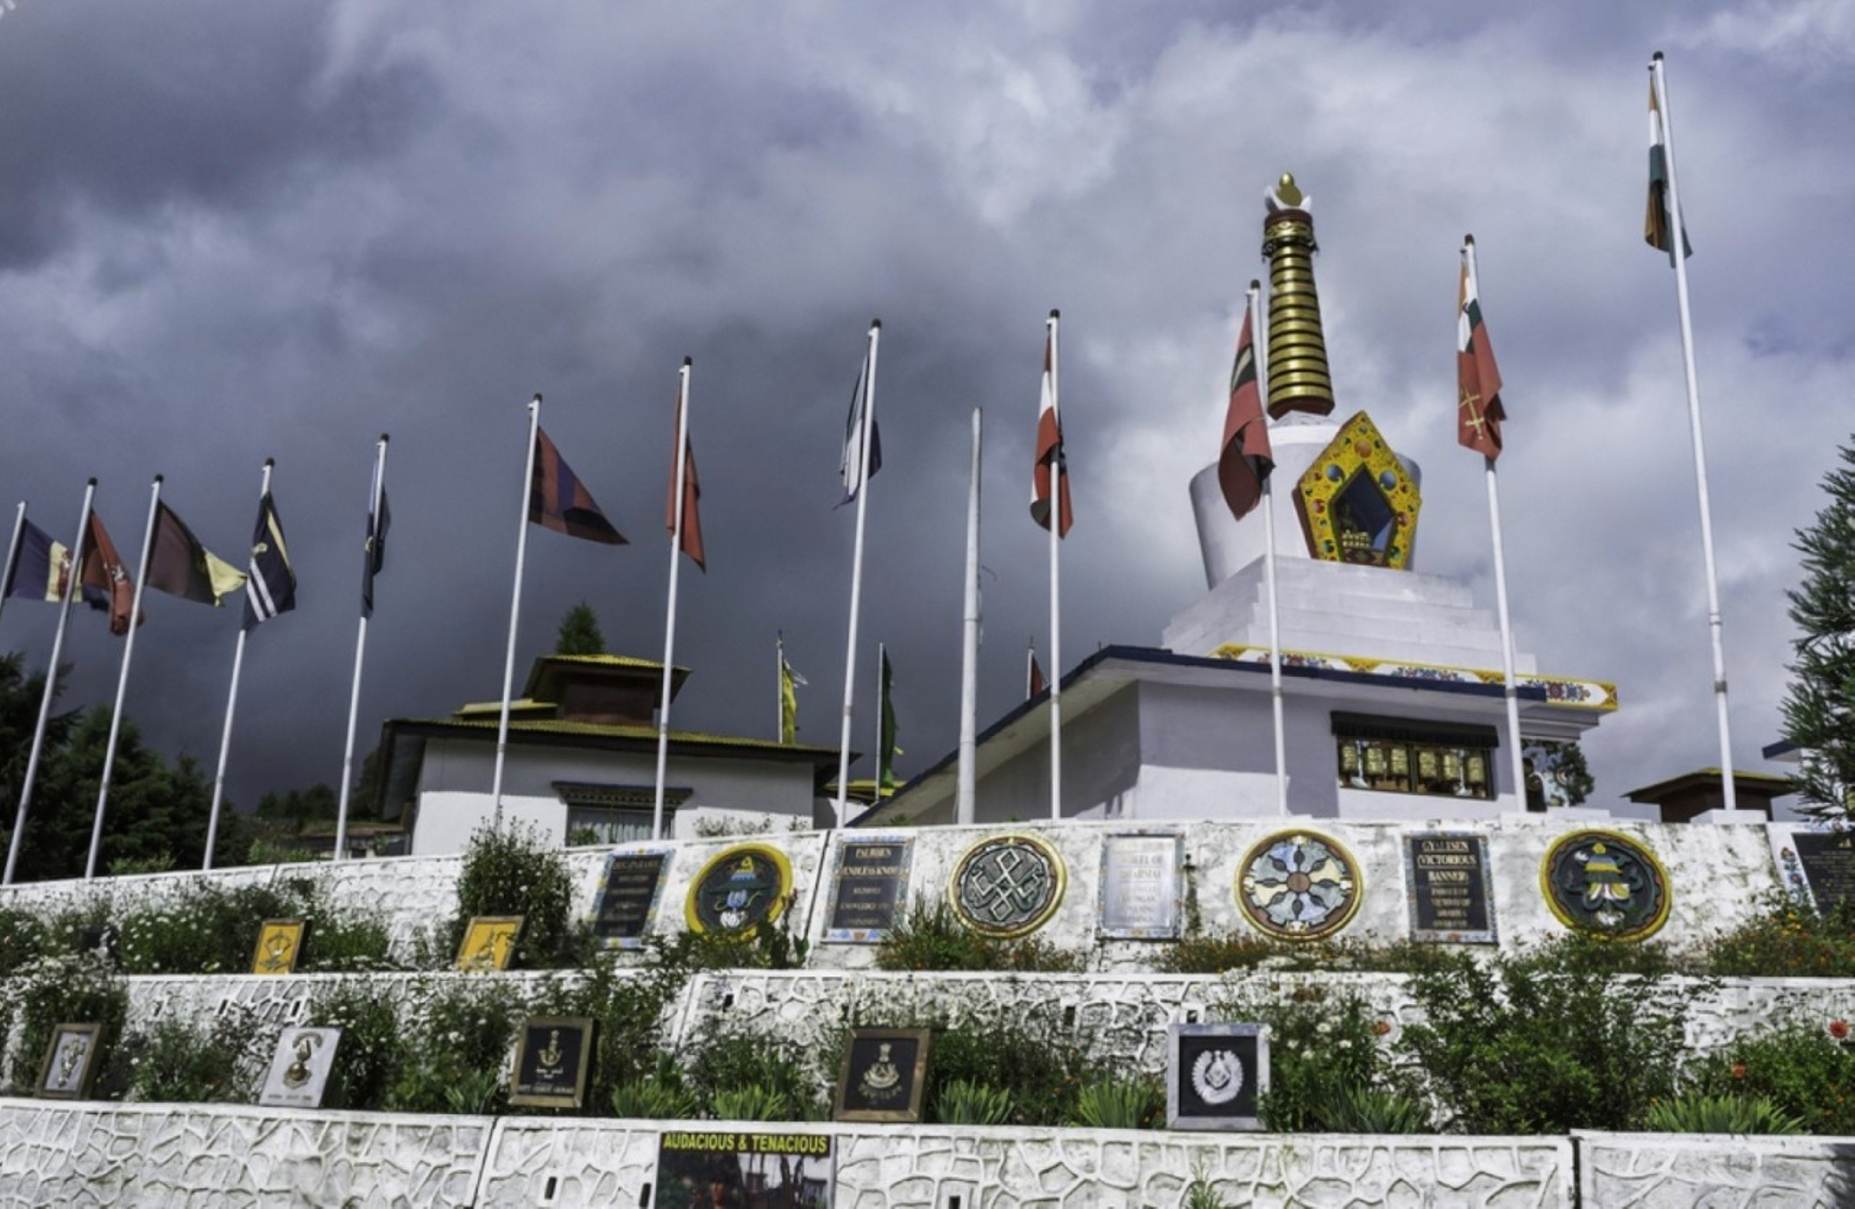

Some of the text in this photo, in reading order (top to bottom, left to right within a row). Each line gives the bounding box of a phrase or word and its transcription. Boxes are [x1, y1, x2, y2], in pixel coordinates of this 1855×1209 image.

[663, 1133, 828, 1153] AUDACIOUS & TENACIOUS
